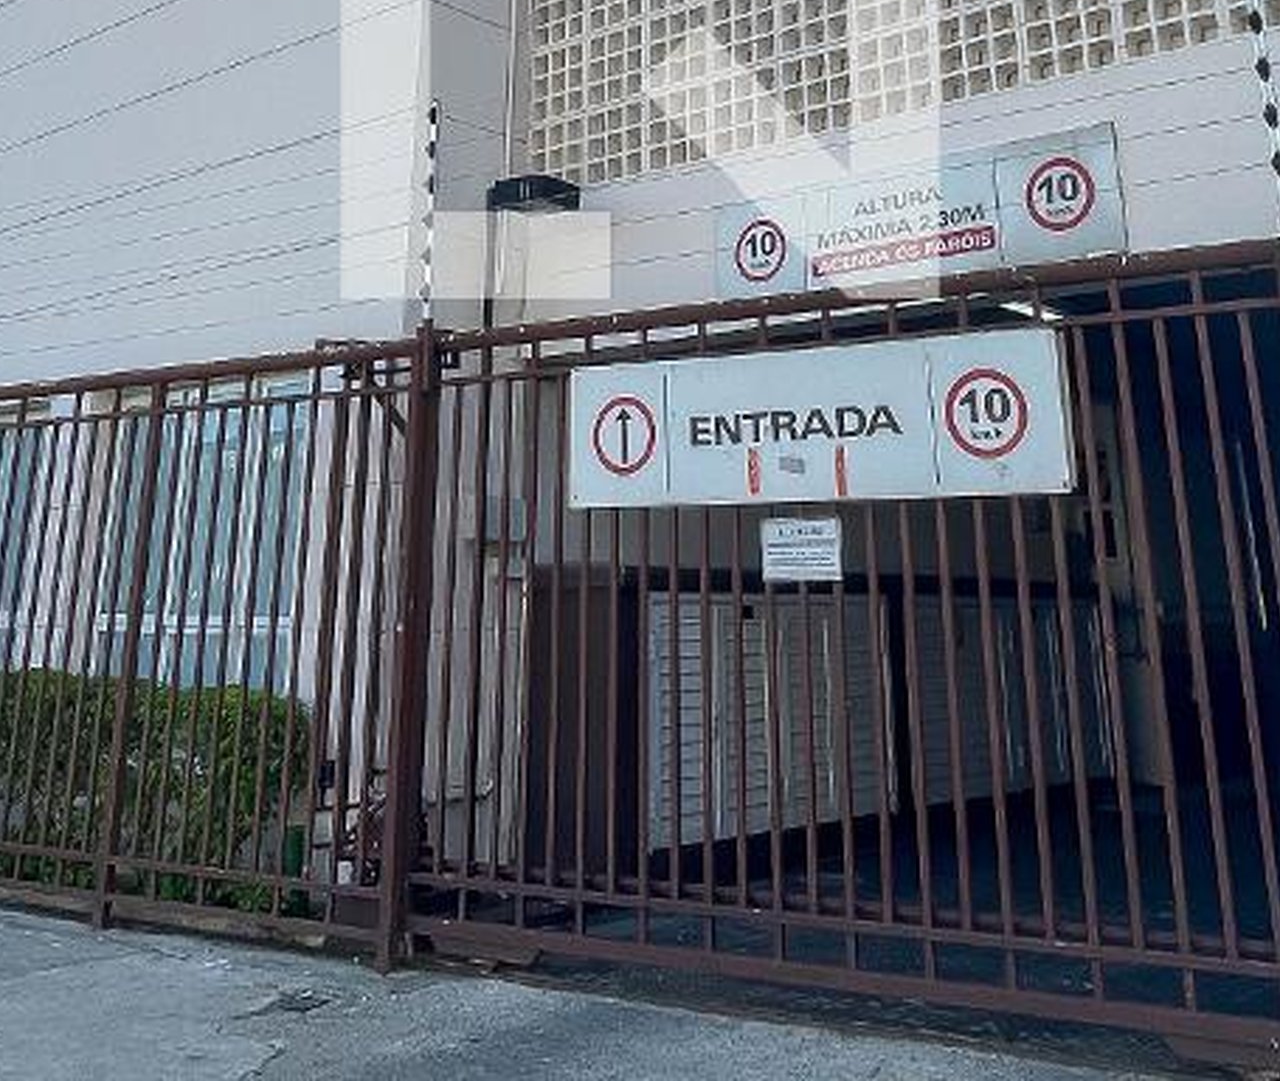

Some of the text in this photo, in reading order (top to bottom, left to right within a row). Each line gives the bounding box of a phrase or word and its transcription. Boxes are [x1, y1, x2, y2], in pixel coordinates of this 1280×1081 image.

[855, 187, 943, 217] ALTURA
[1037, 173, 1080, 203] 10
[745, 231, 777, 258] 10
[959, 388, 1011, 424] 10
[689, 405, 904, 447] ENTRADA
